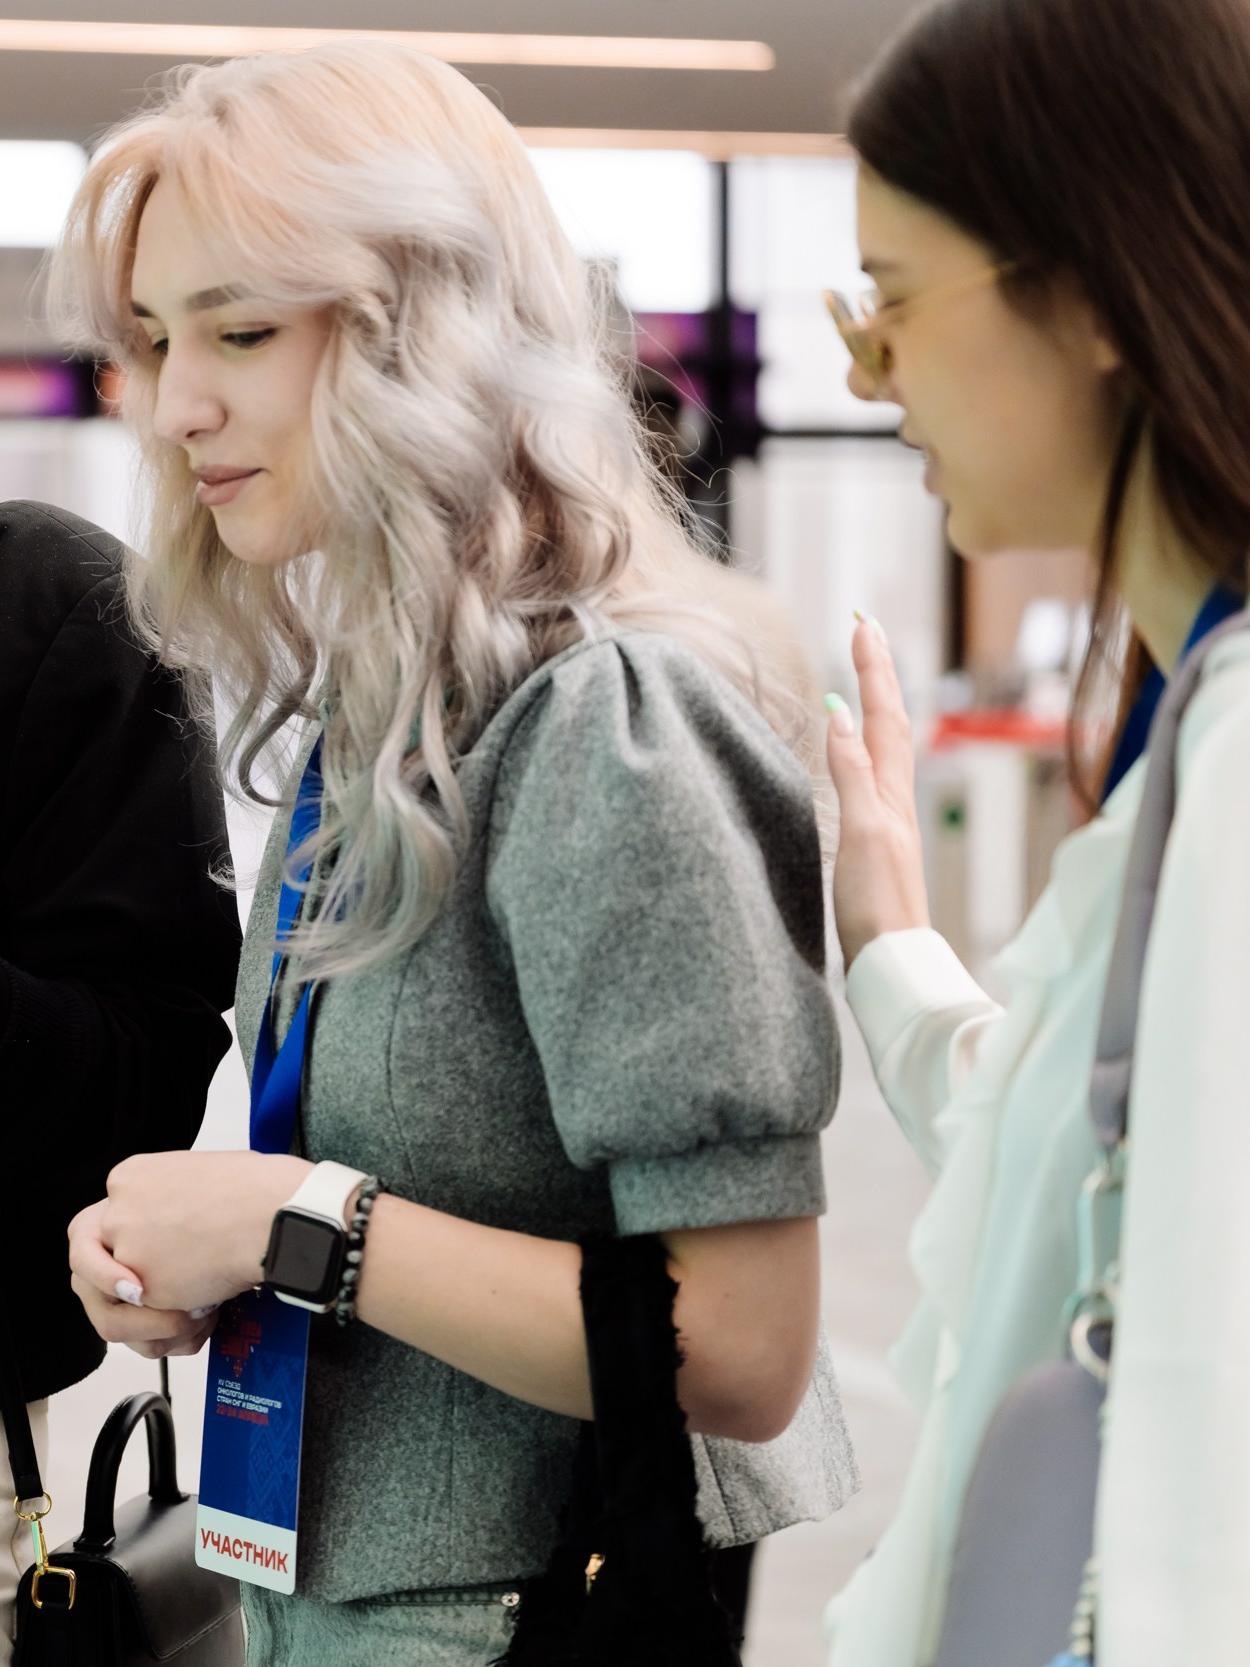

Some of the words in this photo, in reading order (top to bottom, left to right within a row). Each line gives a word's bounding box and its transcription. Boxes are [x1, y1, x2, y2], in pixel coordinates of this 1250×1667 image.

[225, 1380, 241, 1391] СЪЕЗД
[217, 1387, 245, 1400] ОНКОЛОГОВ
[217, 1395, 232, 1405] СТРАН
[200, 1527, 289, 1574] УЧАСТНИК
